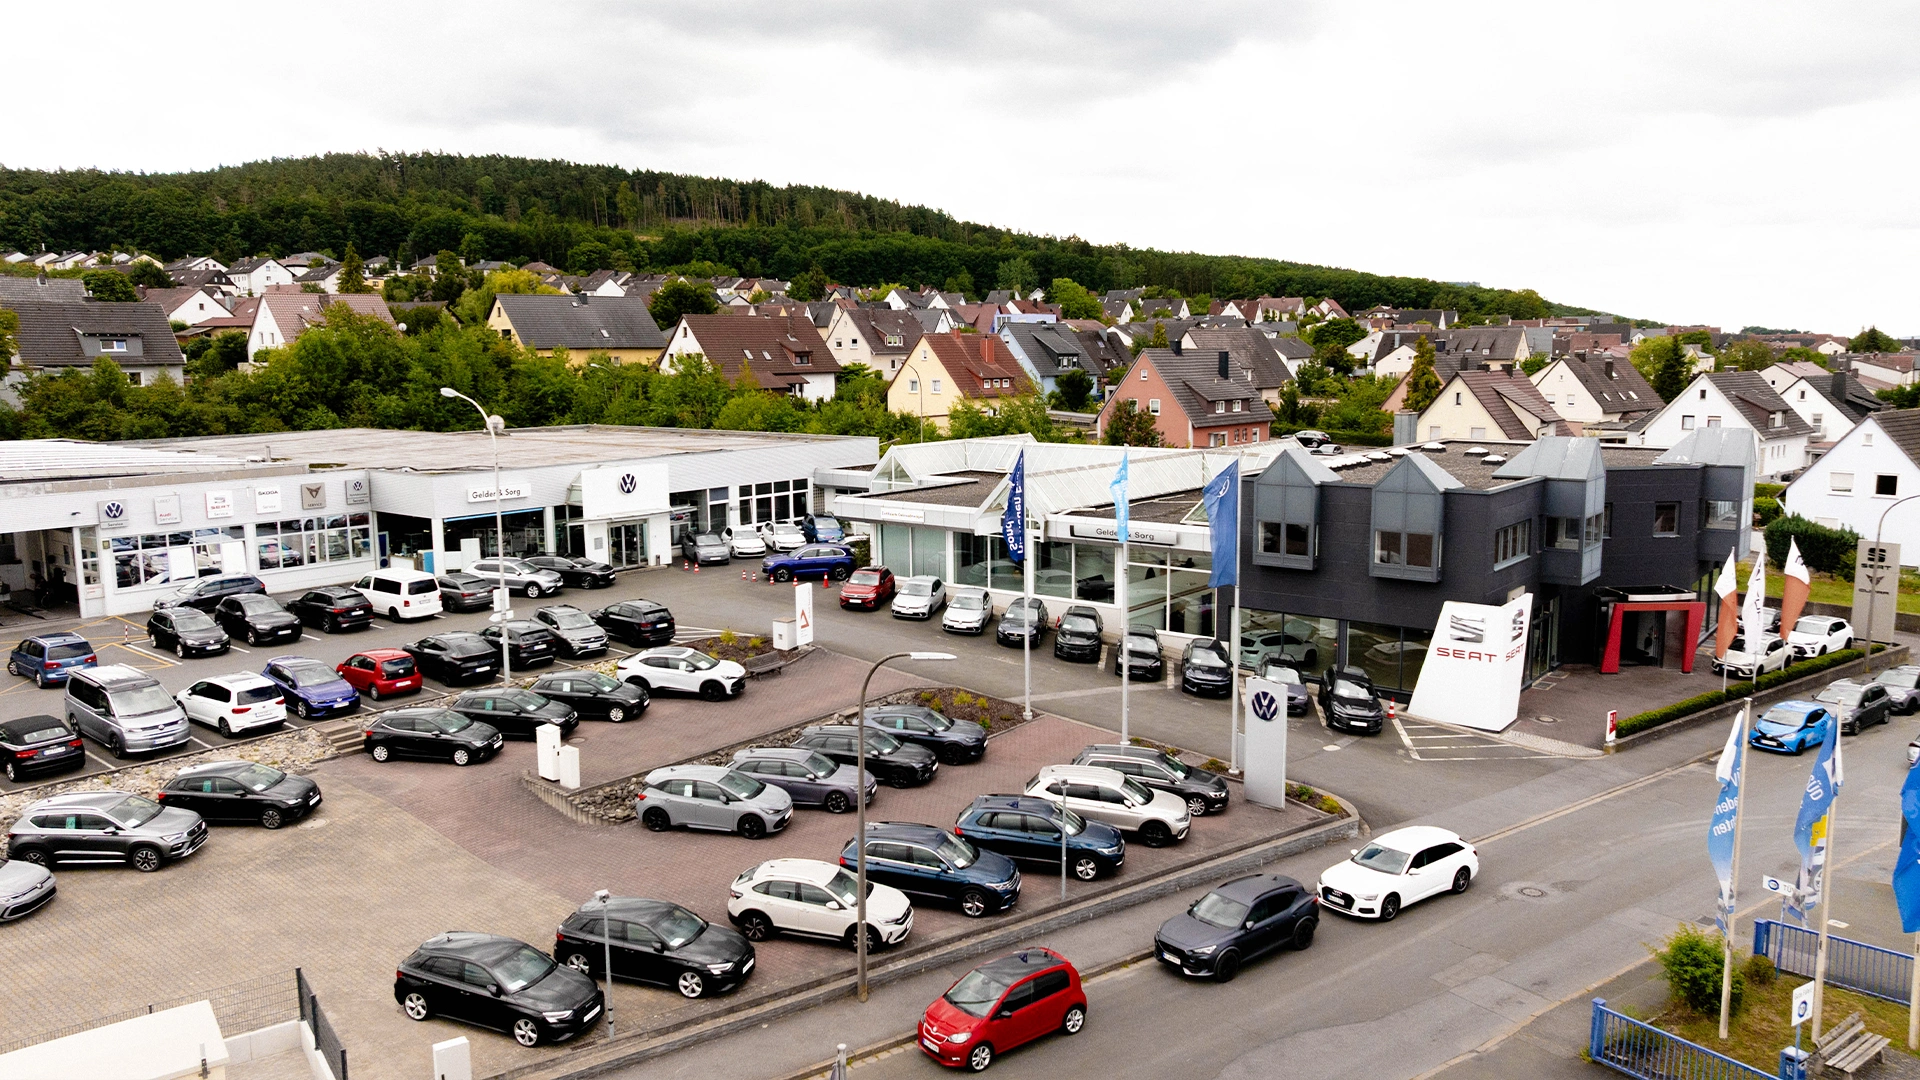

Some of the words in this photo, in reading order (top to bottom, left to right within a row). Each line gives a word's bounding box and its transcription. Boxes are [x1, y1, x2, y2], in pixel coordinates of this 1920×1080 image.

[472, 489, 496, 499] Gelder
[505, 488, 521, 499] Sorg
[1096, 528, 1118, 537] Gelde
[1134, 532, 1154, 541] Sorg
[1436, 646, 1497, 662] SEAT
[1505, 643, 1524, 661] SEAT
